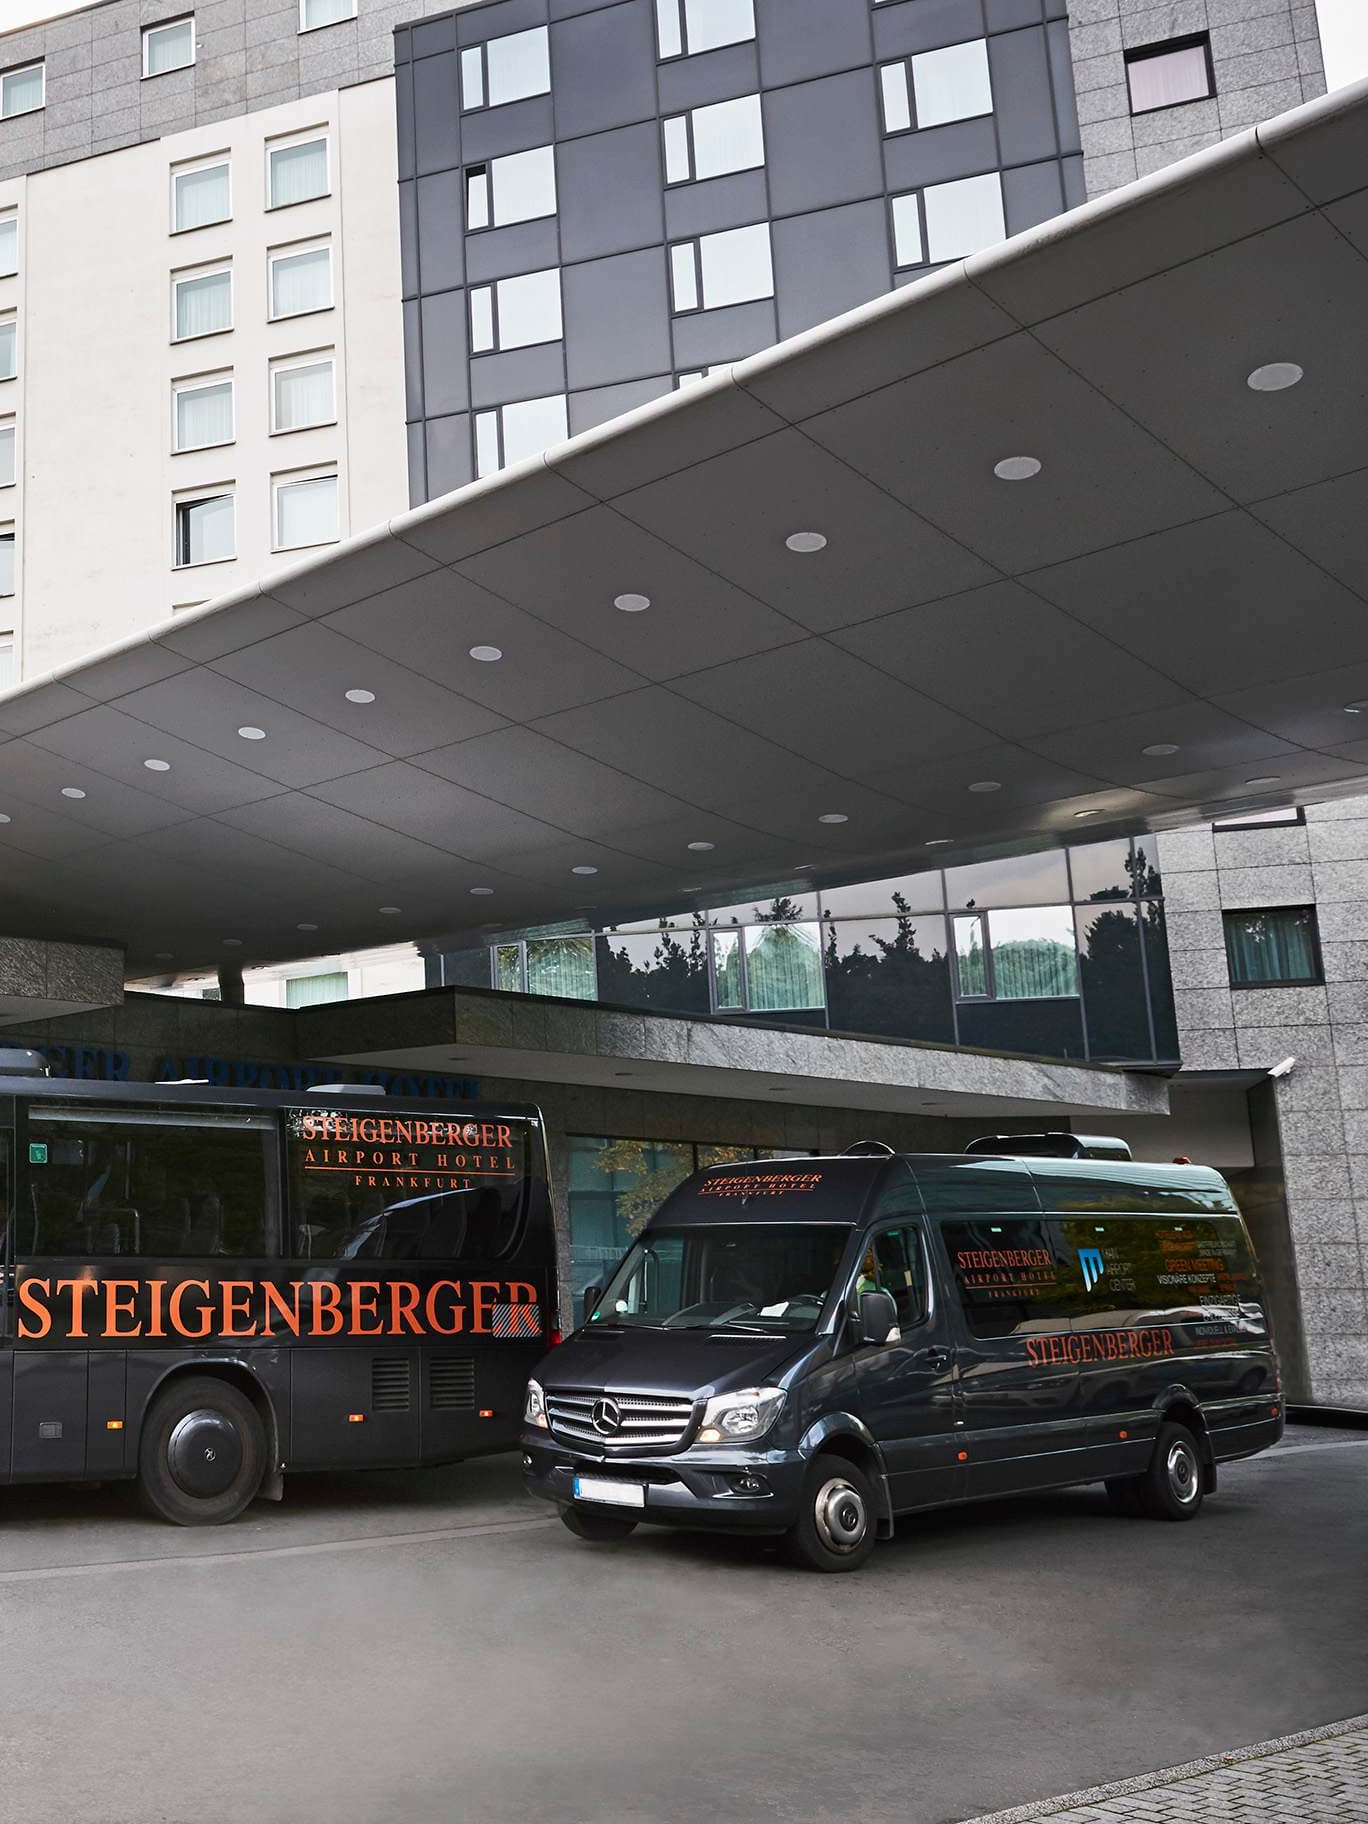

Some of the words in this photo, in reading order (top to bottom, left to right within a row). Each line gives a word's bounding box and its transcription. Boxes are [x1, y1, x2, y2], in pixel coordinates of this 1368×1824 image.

[302, 1115, 513, 1148] STEIGENBERGER
[305, 1148, 419, 1167] AIRPORT
[437, 1154, 515, 1169] HOTEL
[354, 1175, 472, 1190] FRANKFURT
[957, 1249, 1053, 1269] STEIGENBERGER
[17, 1278, 542, 1339] STEIGENBERGER
[1026, 1328, 1176, 1367] STEIGENBERGER
